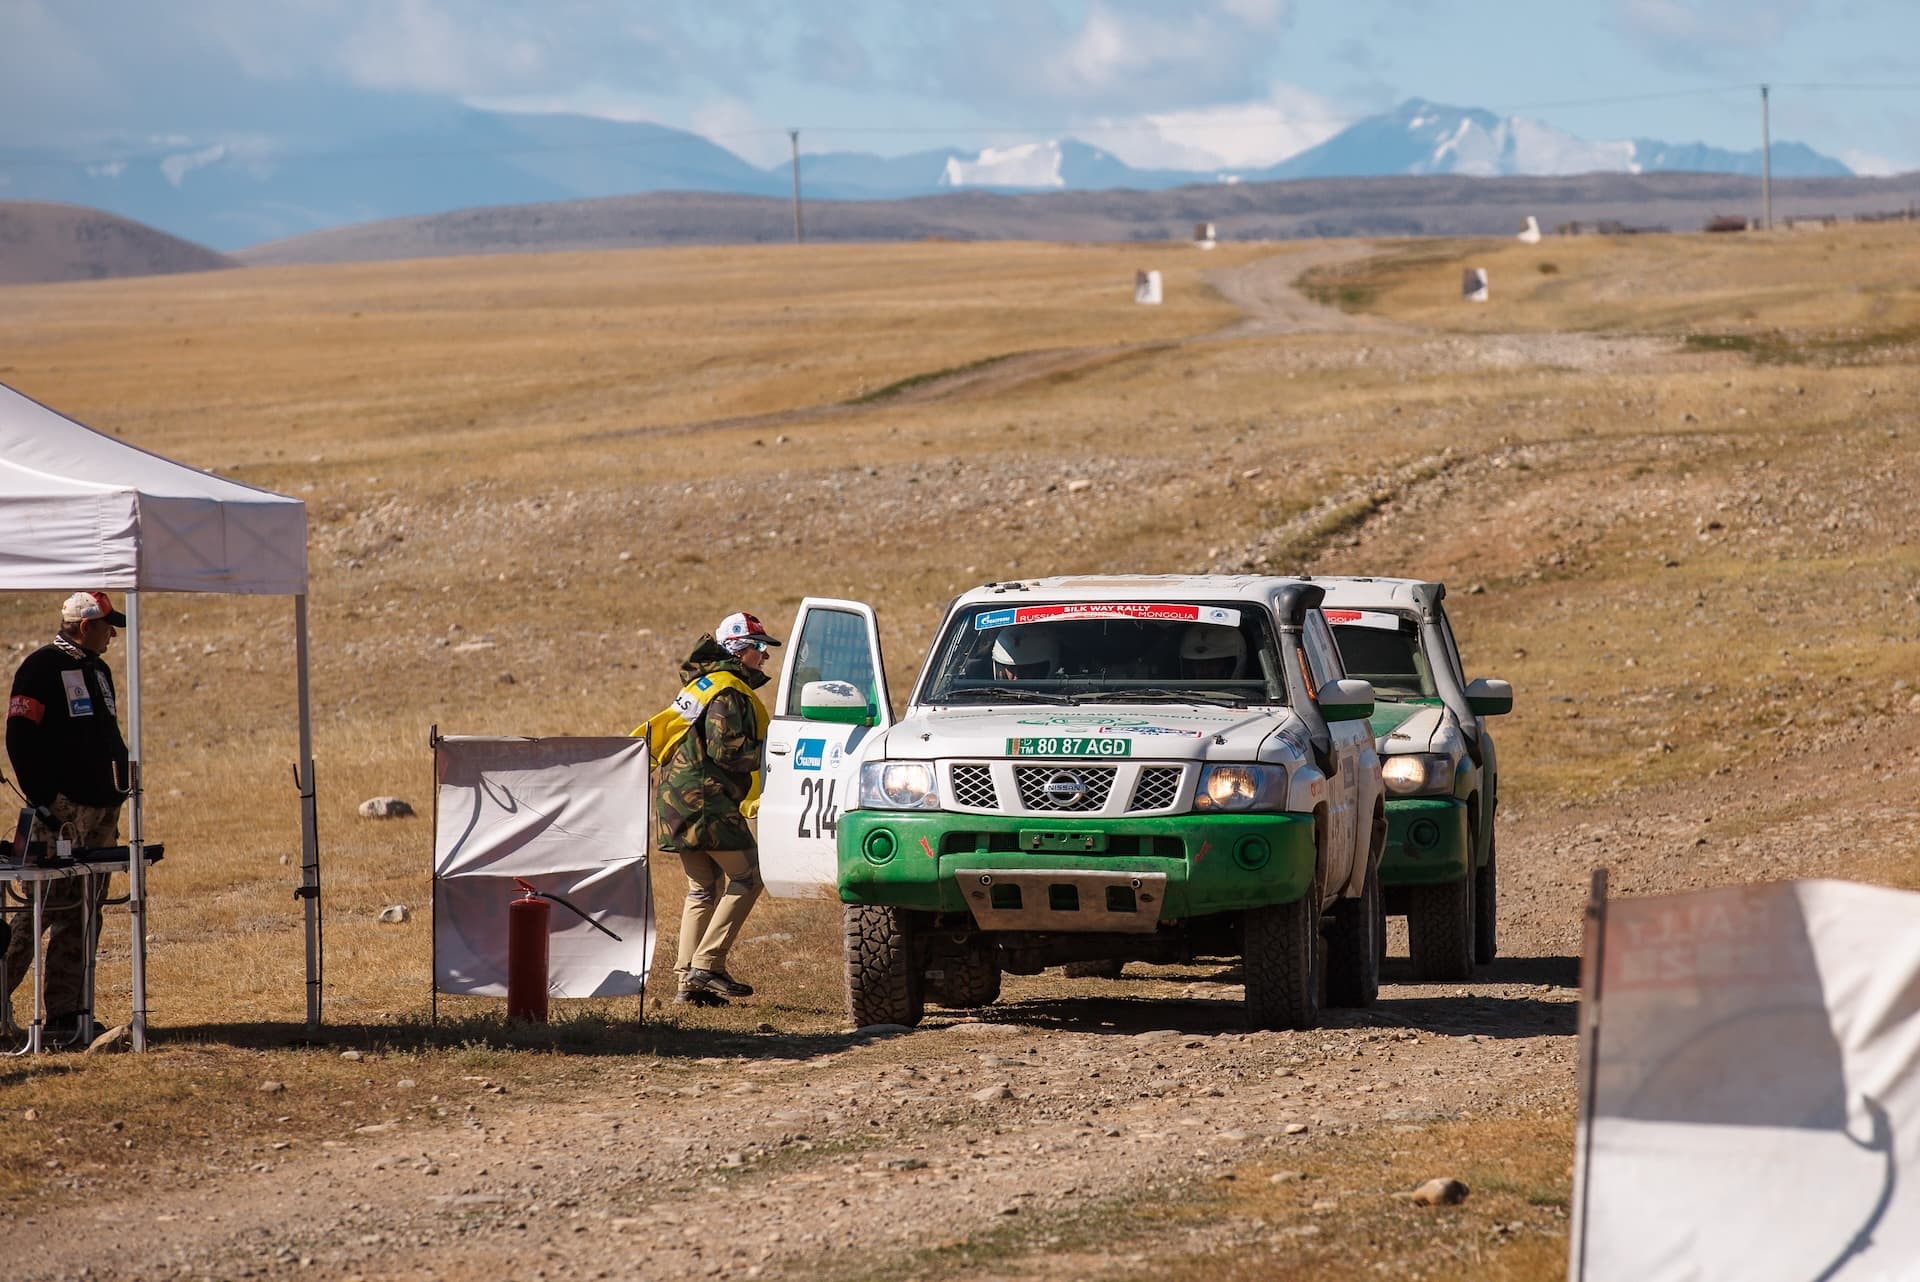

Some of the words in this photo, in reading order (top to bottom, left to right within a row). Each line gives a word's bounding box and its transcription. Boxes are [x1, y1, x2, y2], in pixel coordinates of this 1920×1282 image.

[1138, 611, 1195, 620] MONGOLIA
[1020, 746, 1034, 755] TM
[1037, 738, 1058, 754] 80
[1062, 738, 1083, 754] 87
[1085, 739, 1126, 755] AGD
[1047, 783, 1082, 792] NISSAN
[798, 777, 838, 839] 214
